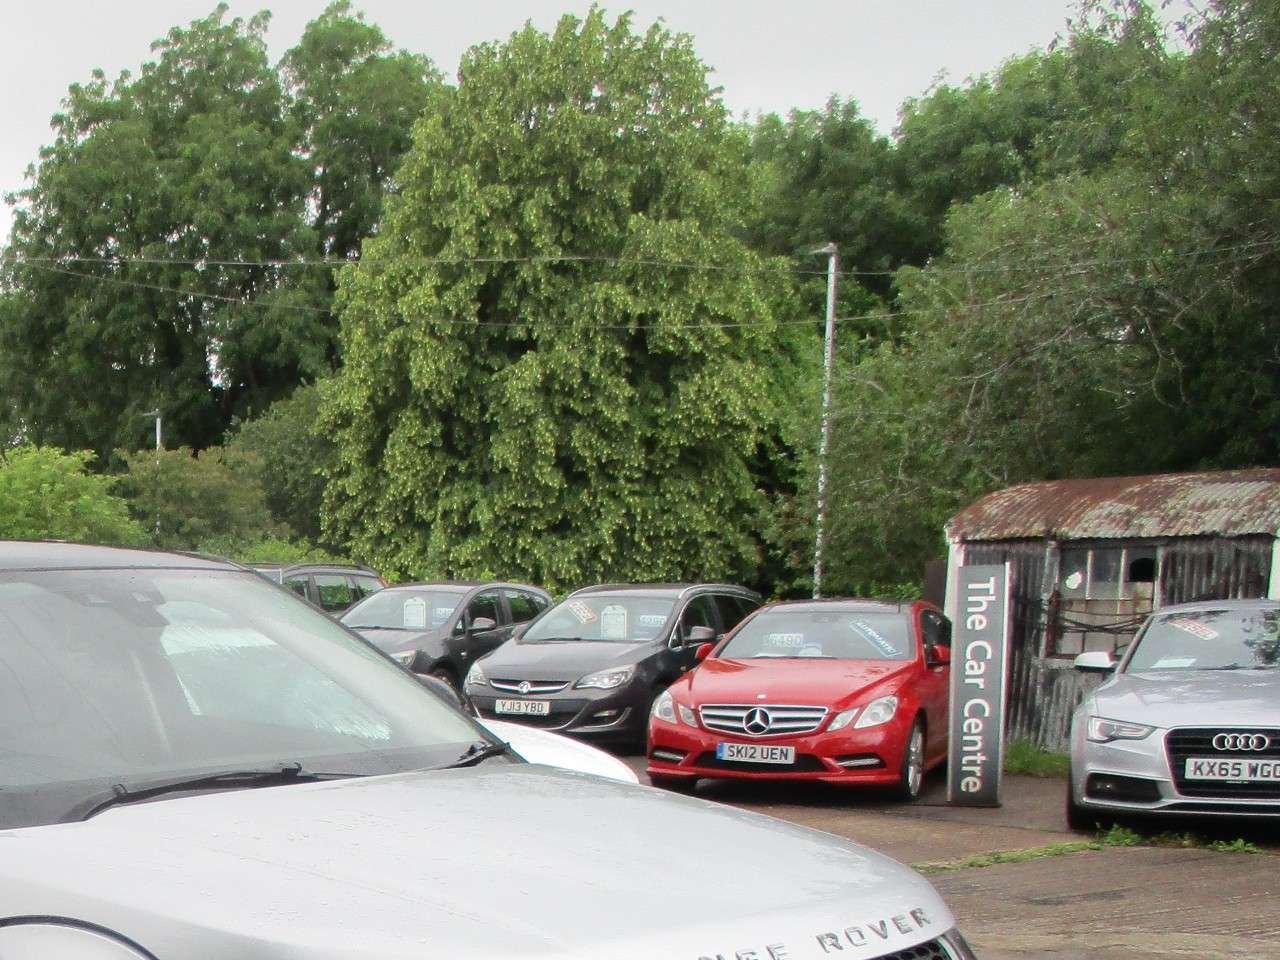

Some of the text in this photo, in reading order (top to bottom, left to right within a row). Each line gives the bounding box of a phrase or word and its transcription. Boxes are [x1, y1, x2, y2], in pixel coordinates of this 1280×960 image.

[961, 576, 996, 793] The Car Centre
[728, 745, 789, 761] SK12 UEN
[1193, 761, 1242, 777] KX65
[816, 908, 931, 954] ROVER
